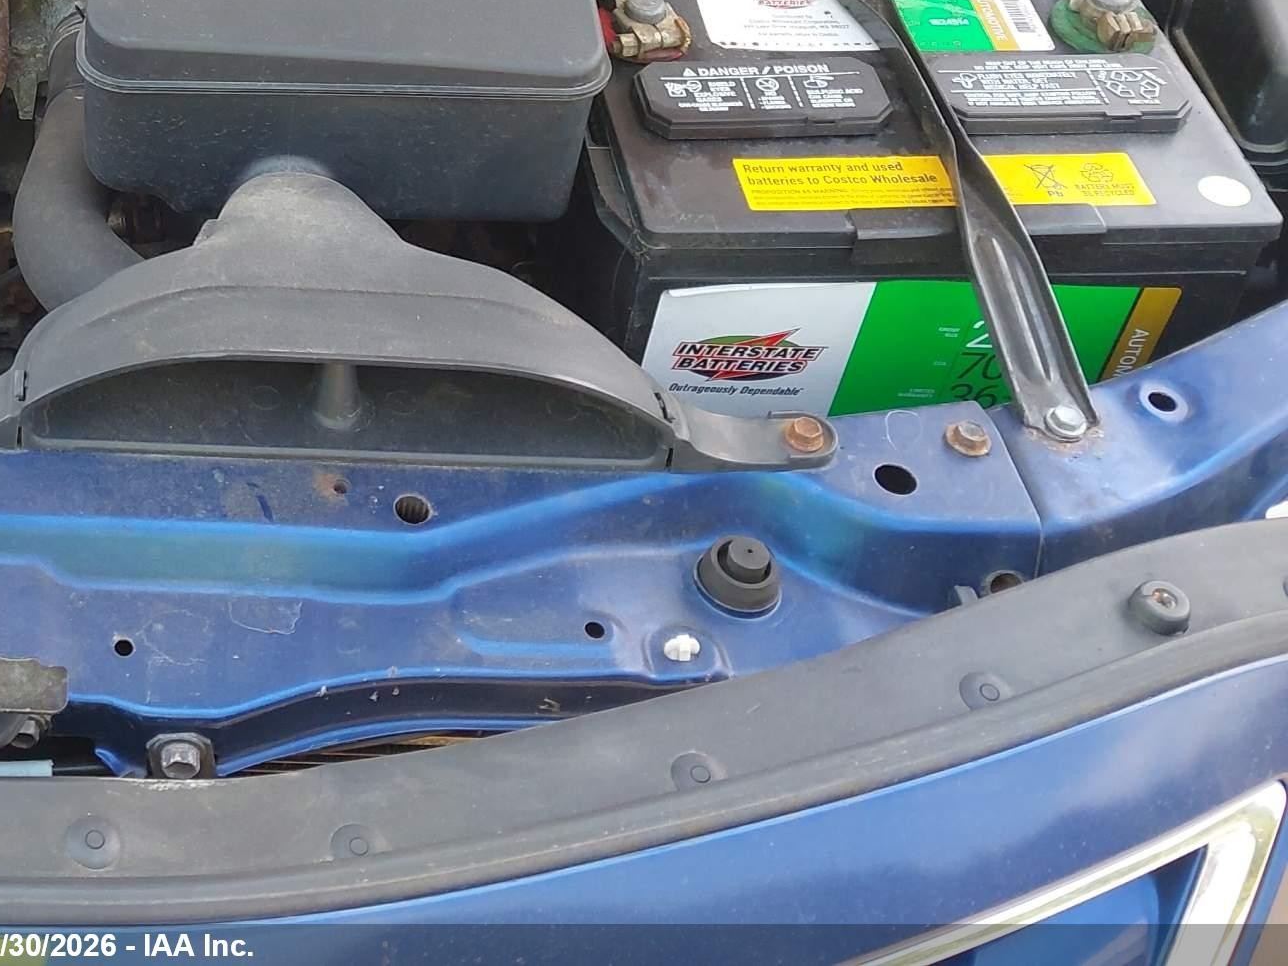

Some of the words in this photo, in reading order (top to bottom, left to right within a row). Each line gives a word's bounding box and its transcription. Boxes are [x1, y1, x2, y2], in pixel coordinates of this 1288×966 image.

[697, 66, 760, 76] DANGER
[774, 64, 830, 74] POISON
[743, 164, 785, 173] Return
[788, 163, 842, 174] warranty
[847, 162, 869, 172] and
[873, 161, 903, 171] used
[747, 176, 803, 186] batteries
[807, 176, 819, 185] to
[823, 174, 867, 184] Costco
[871, 173, 938, 184] Wholesale
[678, 344, 822, 359] INTERSTATE
[677, 357, 805, 372] BATTERIES
[669, 383, 738, 395] Outrageously
